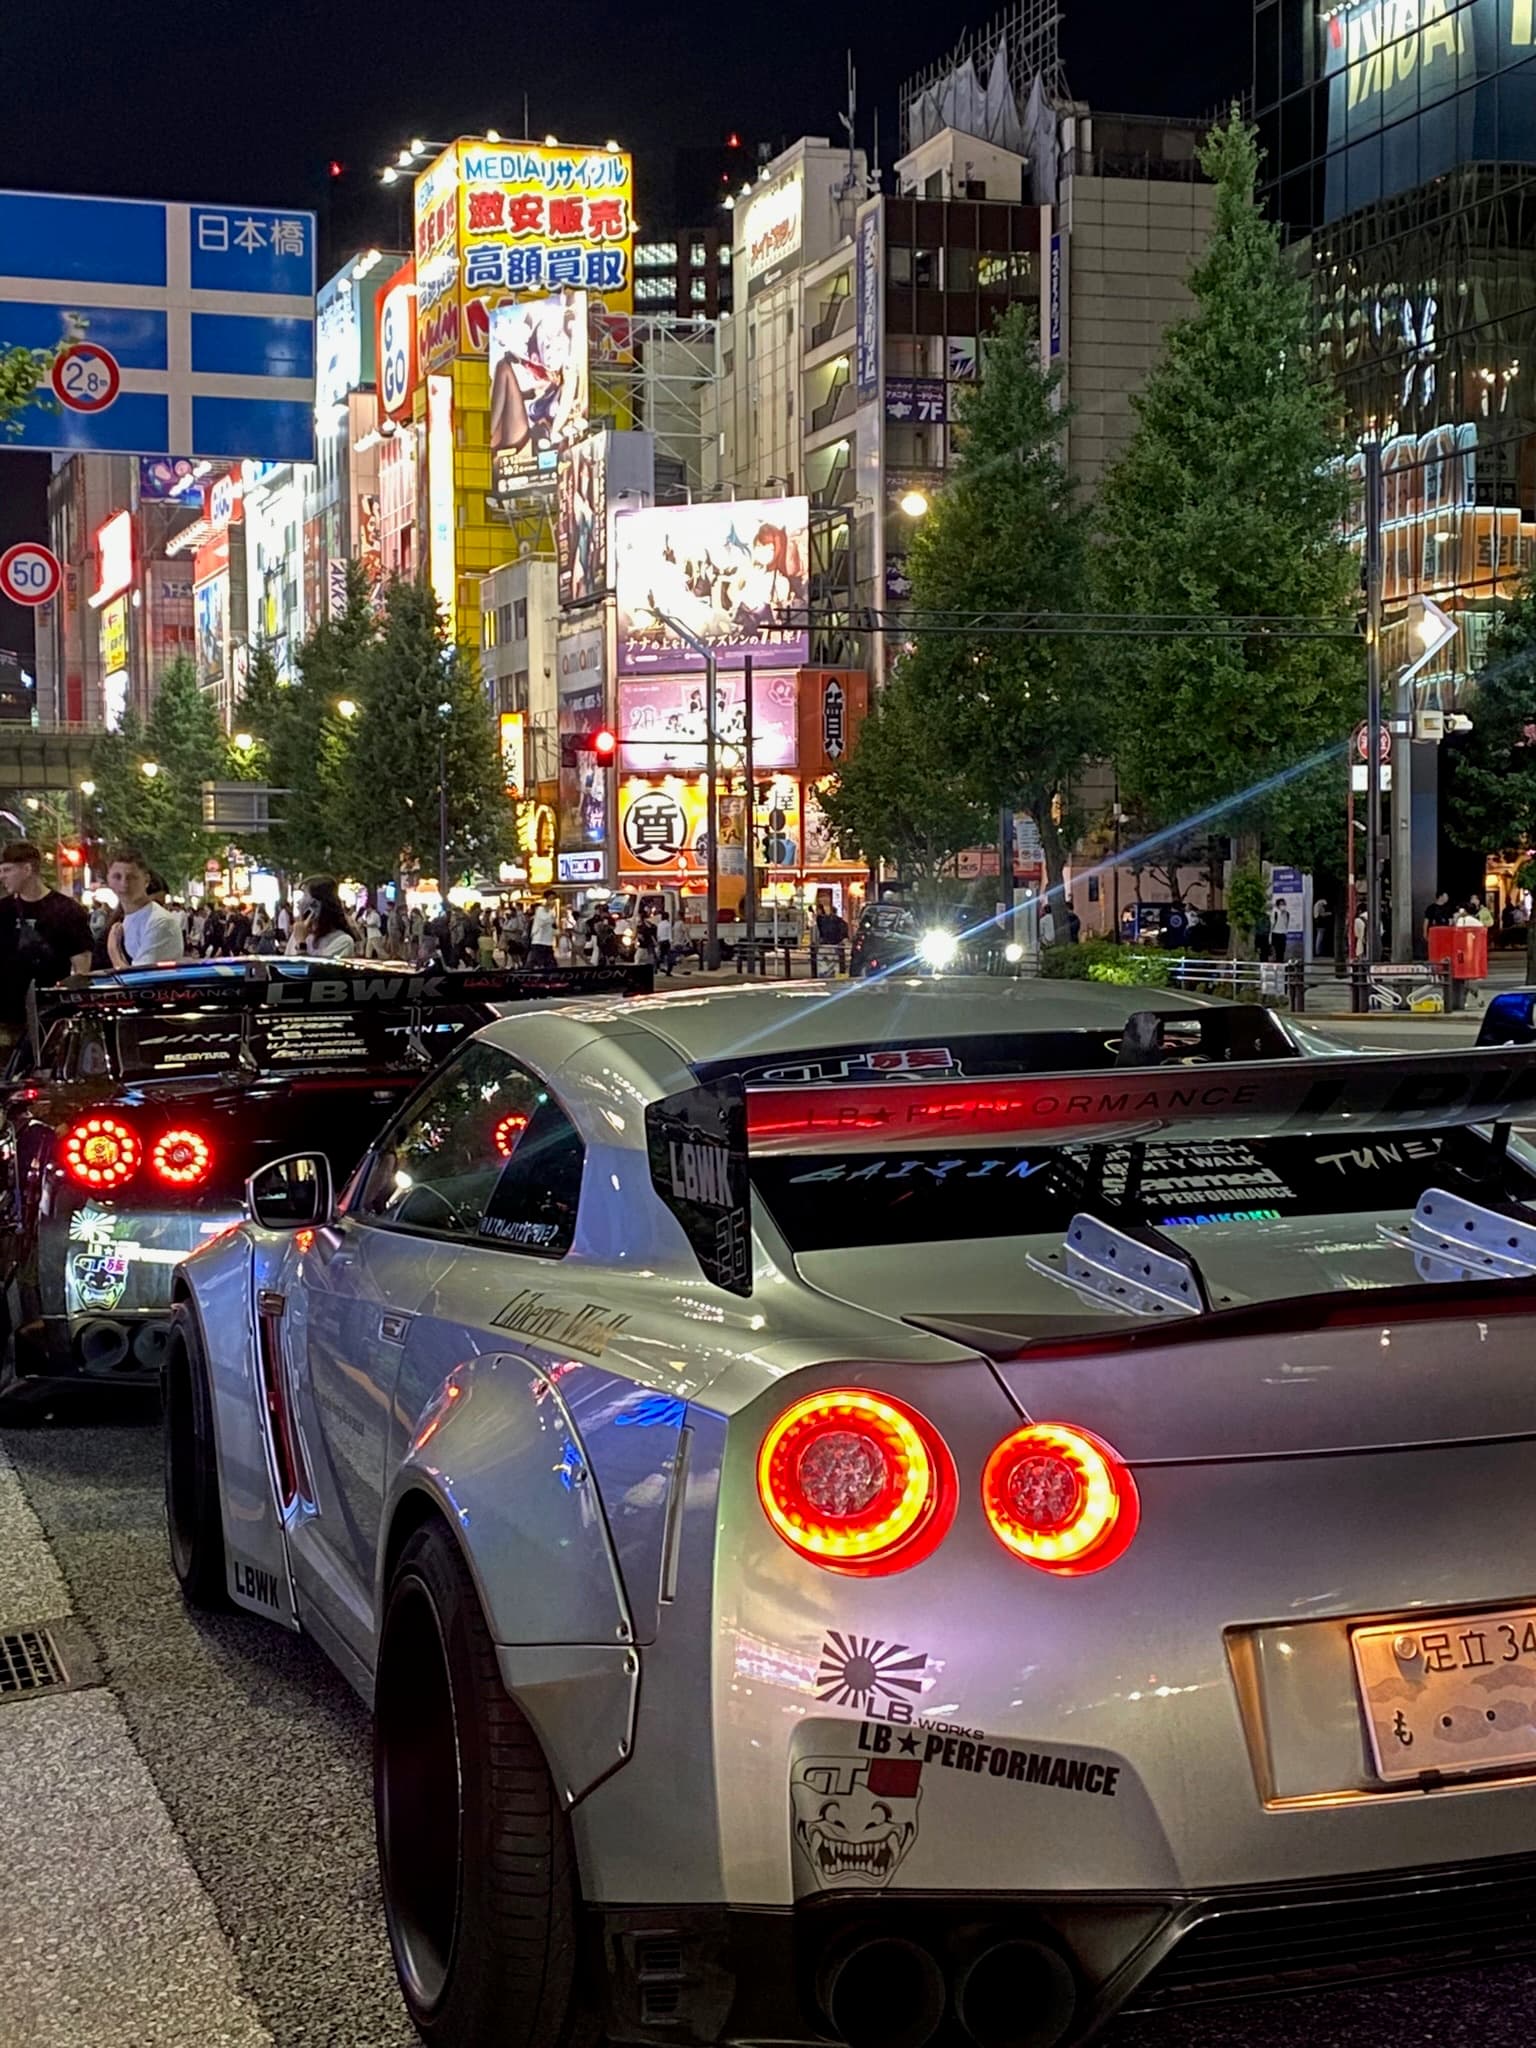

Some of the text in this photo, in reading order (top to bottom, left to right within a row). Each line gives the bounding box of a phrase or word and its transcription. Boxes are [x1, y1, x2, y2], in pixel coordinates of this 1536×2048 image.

[198, 214, 304, 257] 日本橋
[468, 193, 625, 237] 激安販売
[466, 246, 624, 288] 高額買取
[917, 402, 943, 421] 7F
[13, 560, 47, 588] 50
[632, 803, 680, 855] 質
[265, 976, 446, 1005] LBWK
[668, 1141, 735, 1208] LBWK
[1197, 1154, 1264, 1169] WALK
[1159, 1186, 1298, 1206] PERFORMANCE
[490, 1289, 570, 1342] Liberty
[234, 1561, 280, 1610] LBWK
[1421, 1631, 1493, 1674] 足立
[1393, 1709, 1414, 1746] も
[858, 1721, 1120, 1797] LB PERFORMANCE
